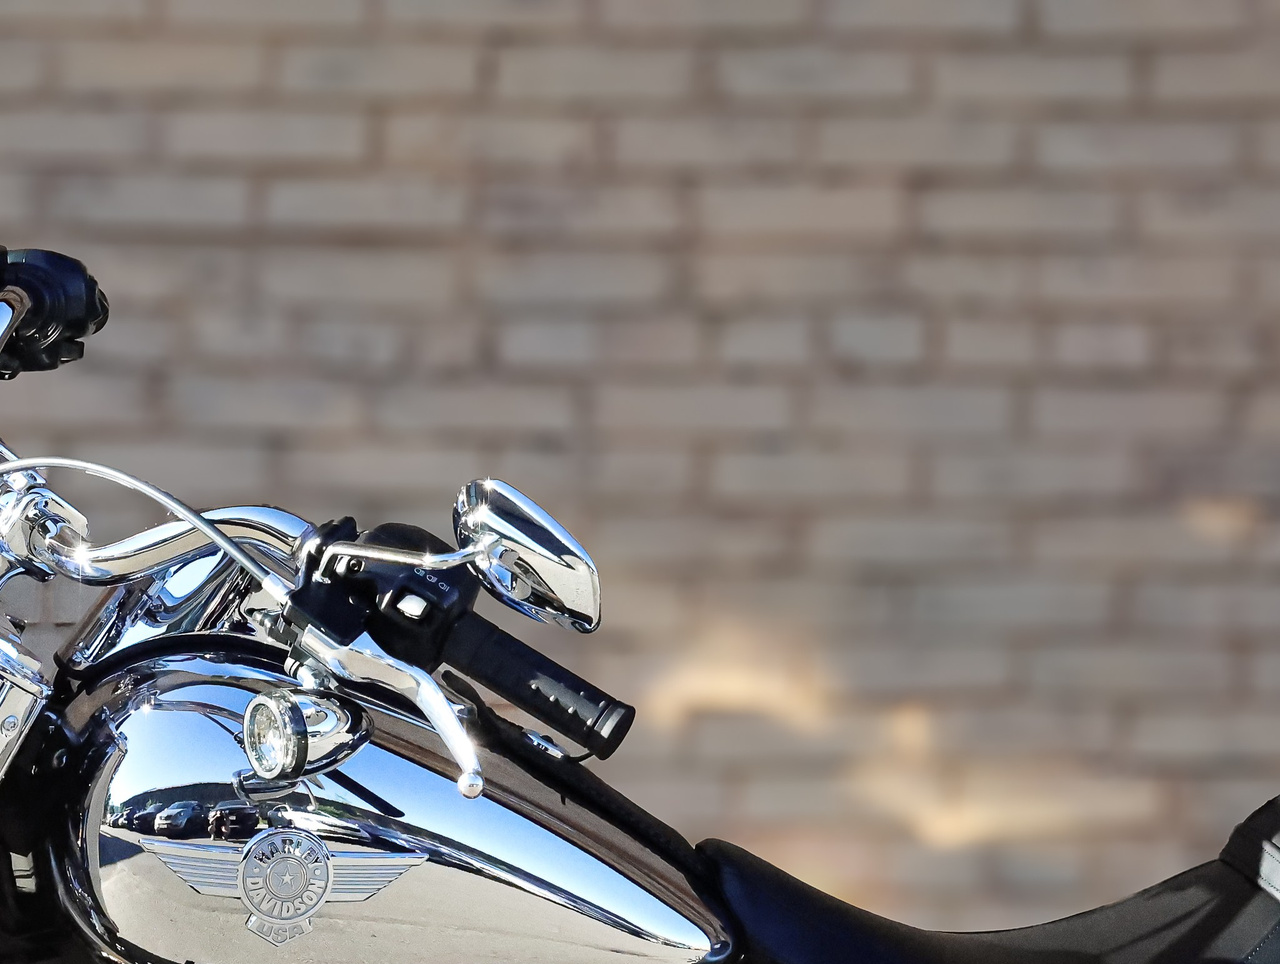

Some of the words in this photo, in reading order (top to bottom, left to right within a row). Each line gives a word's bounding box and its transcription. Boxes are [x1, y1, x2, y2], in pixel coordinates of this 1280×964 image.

[254, 837, 324, 867] HARLEY
[246, 877, 326, 917] DAVIDSON
[256, 922, 305, 944] USA
